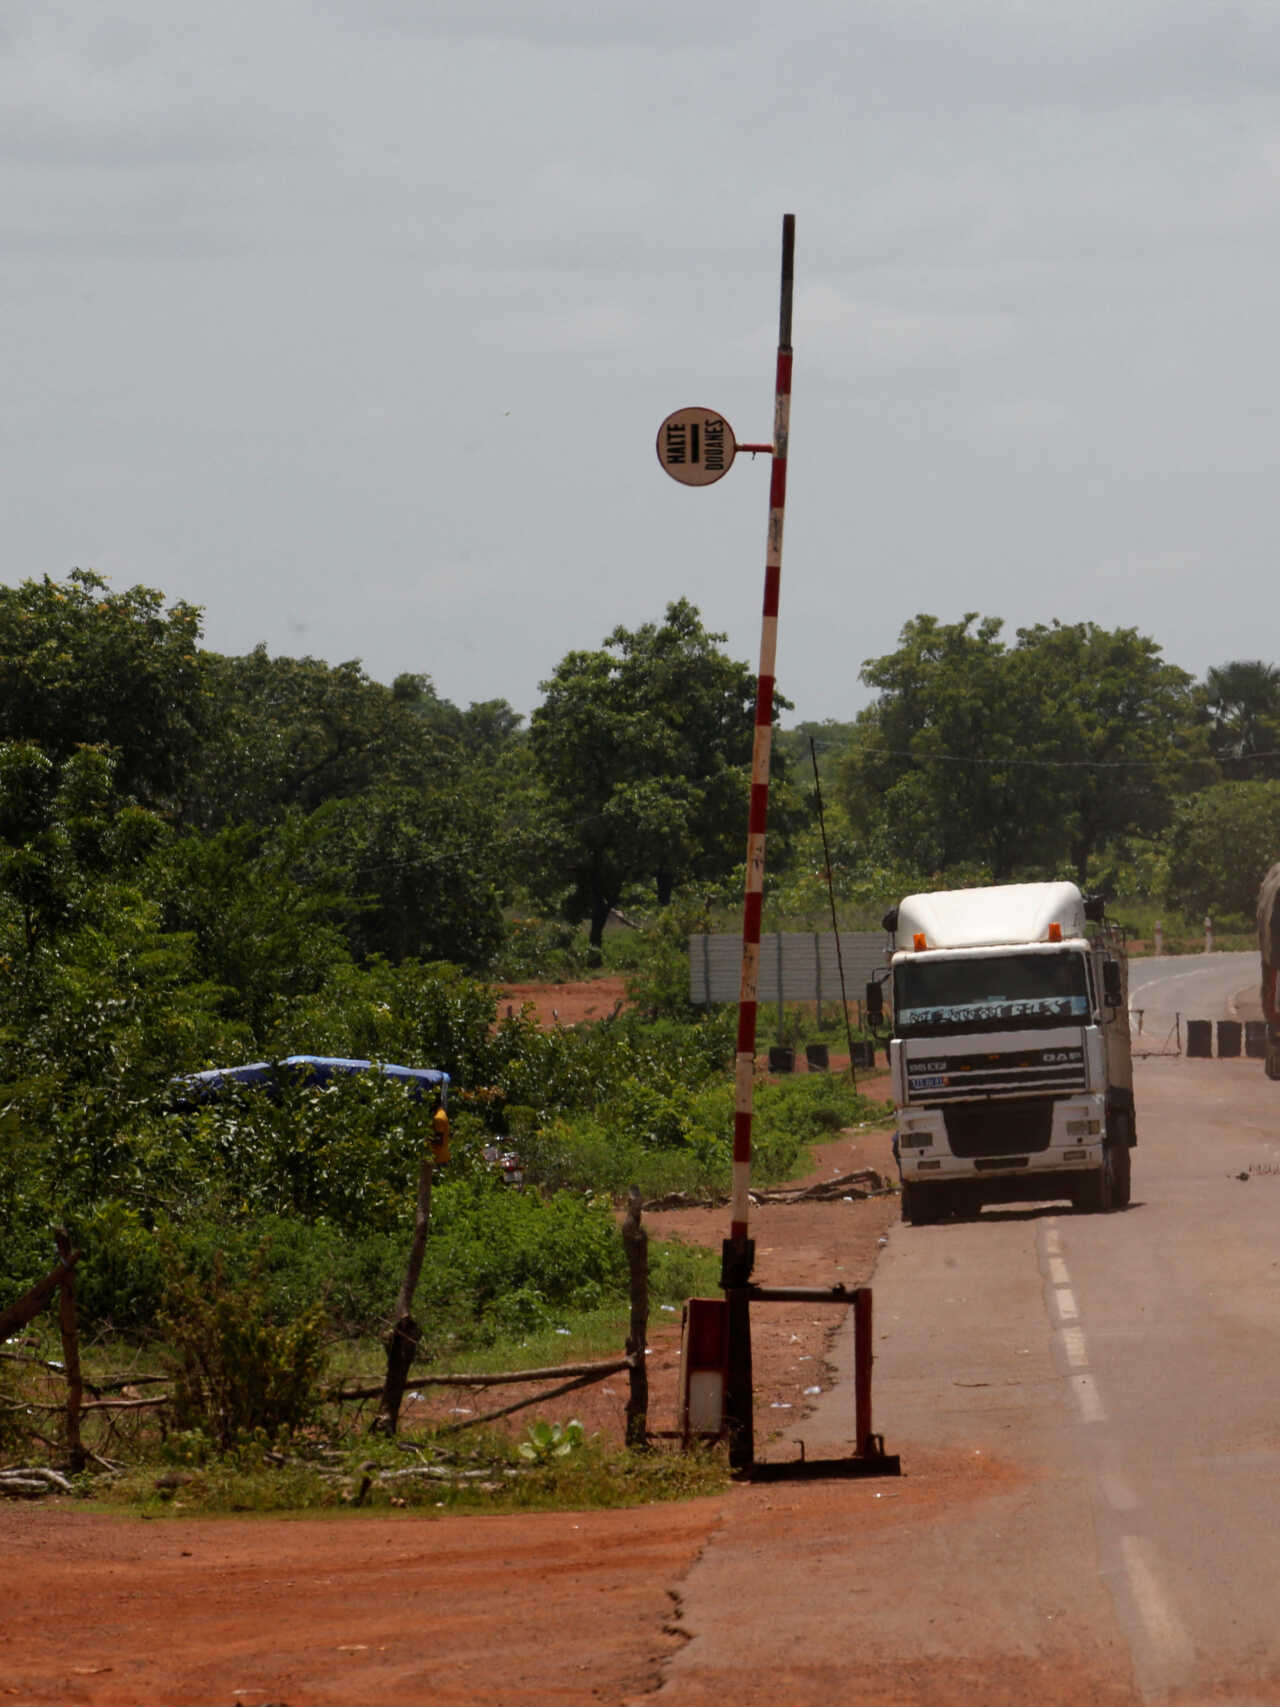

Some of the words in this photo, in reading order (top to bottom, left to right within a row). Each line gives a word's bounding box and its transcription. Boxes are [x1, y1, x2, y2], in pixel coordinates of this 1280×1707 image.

[667, 423, 686, 464] HALTE
[704, 419, 724, 471] DOUANES
[1042, 1052, 1081, 1063] DAF
